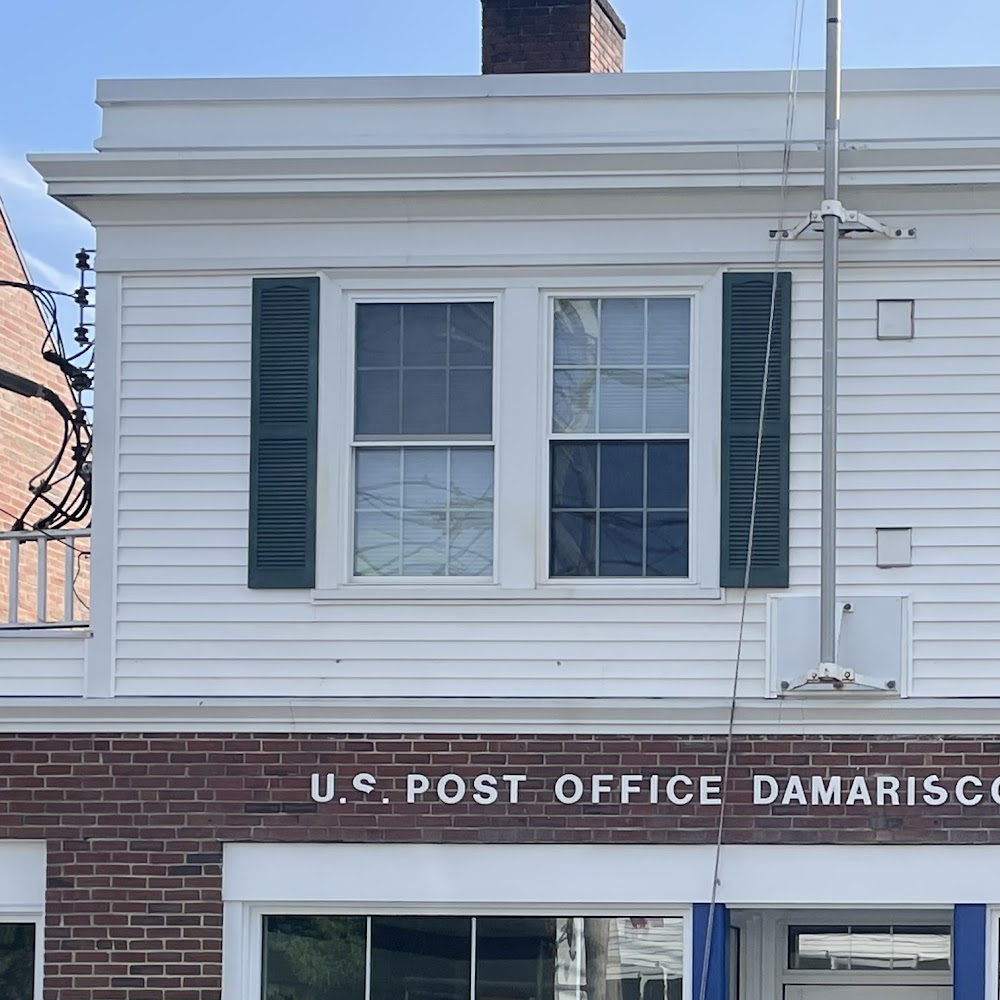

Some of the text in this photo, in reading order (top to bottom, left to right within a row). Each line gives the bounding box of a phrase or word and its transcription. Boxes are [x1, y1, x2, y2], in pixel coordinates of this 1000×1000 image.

[311, 773, 389, 804] U.S.
[407, 773, 527, 805] POST
[554, 774, 722, 805] OFFICE
